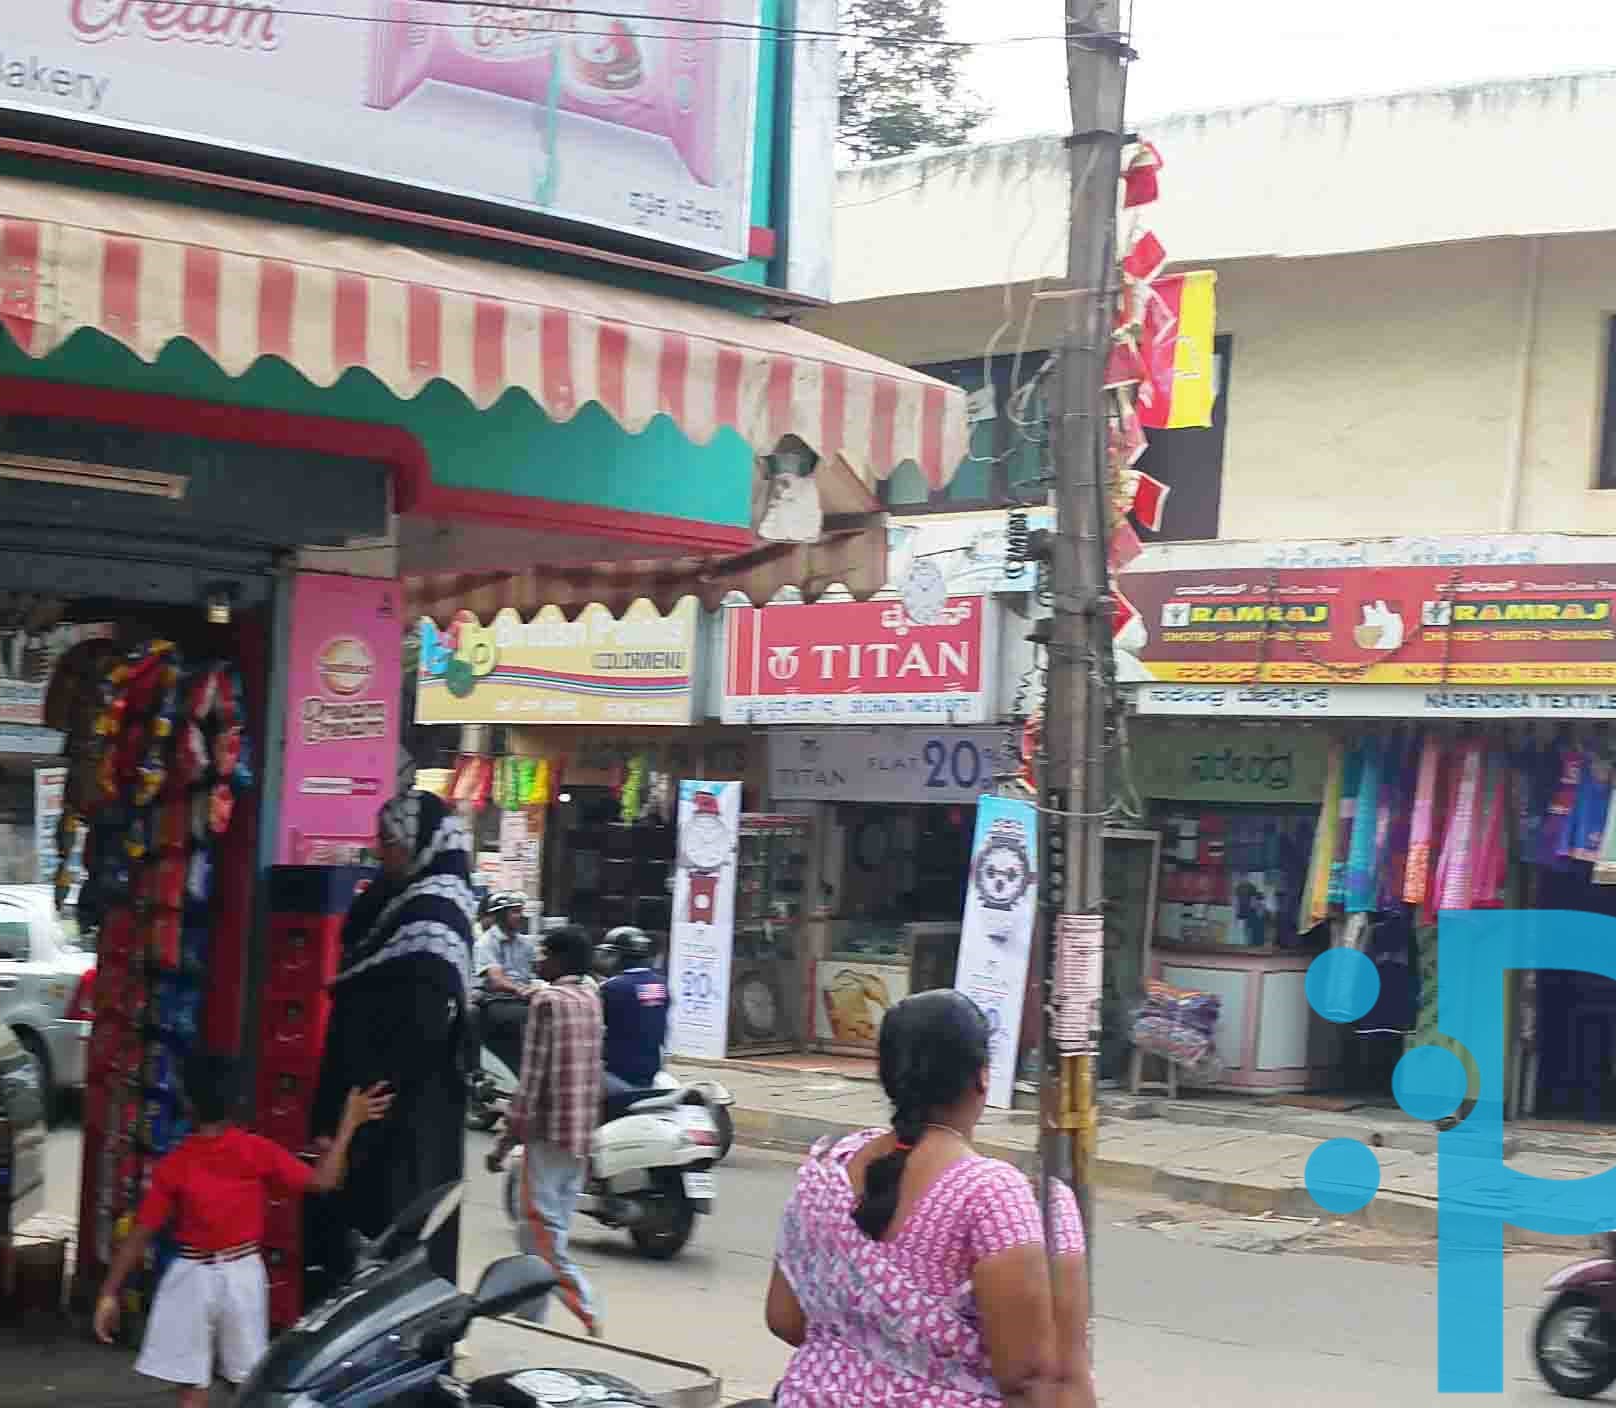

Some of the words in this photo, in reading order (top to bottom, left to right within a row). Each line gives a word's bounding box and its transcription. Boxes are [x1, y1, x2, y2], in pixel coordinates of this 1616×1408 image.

[1453, 602, 1610, 621] RAMRAJ
[811, 640, 970, 680] TITAN
[1520, 666, 1616, 679] TEXTILES
[1424, 692, 1531, 709] NARENDRA
[776, 768, 848, 787] TITAN
